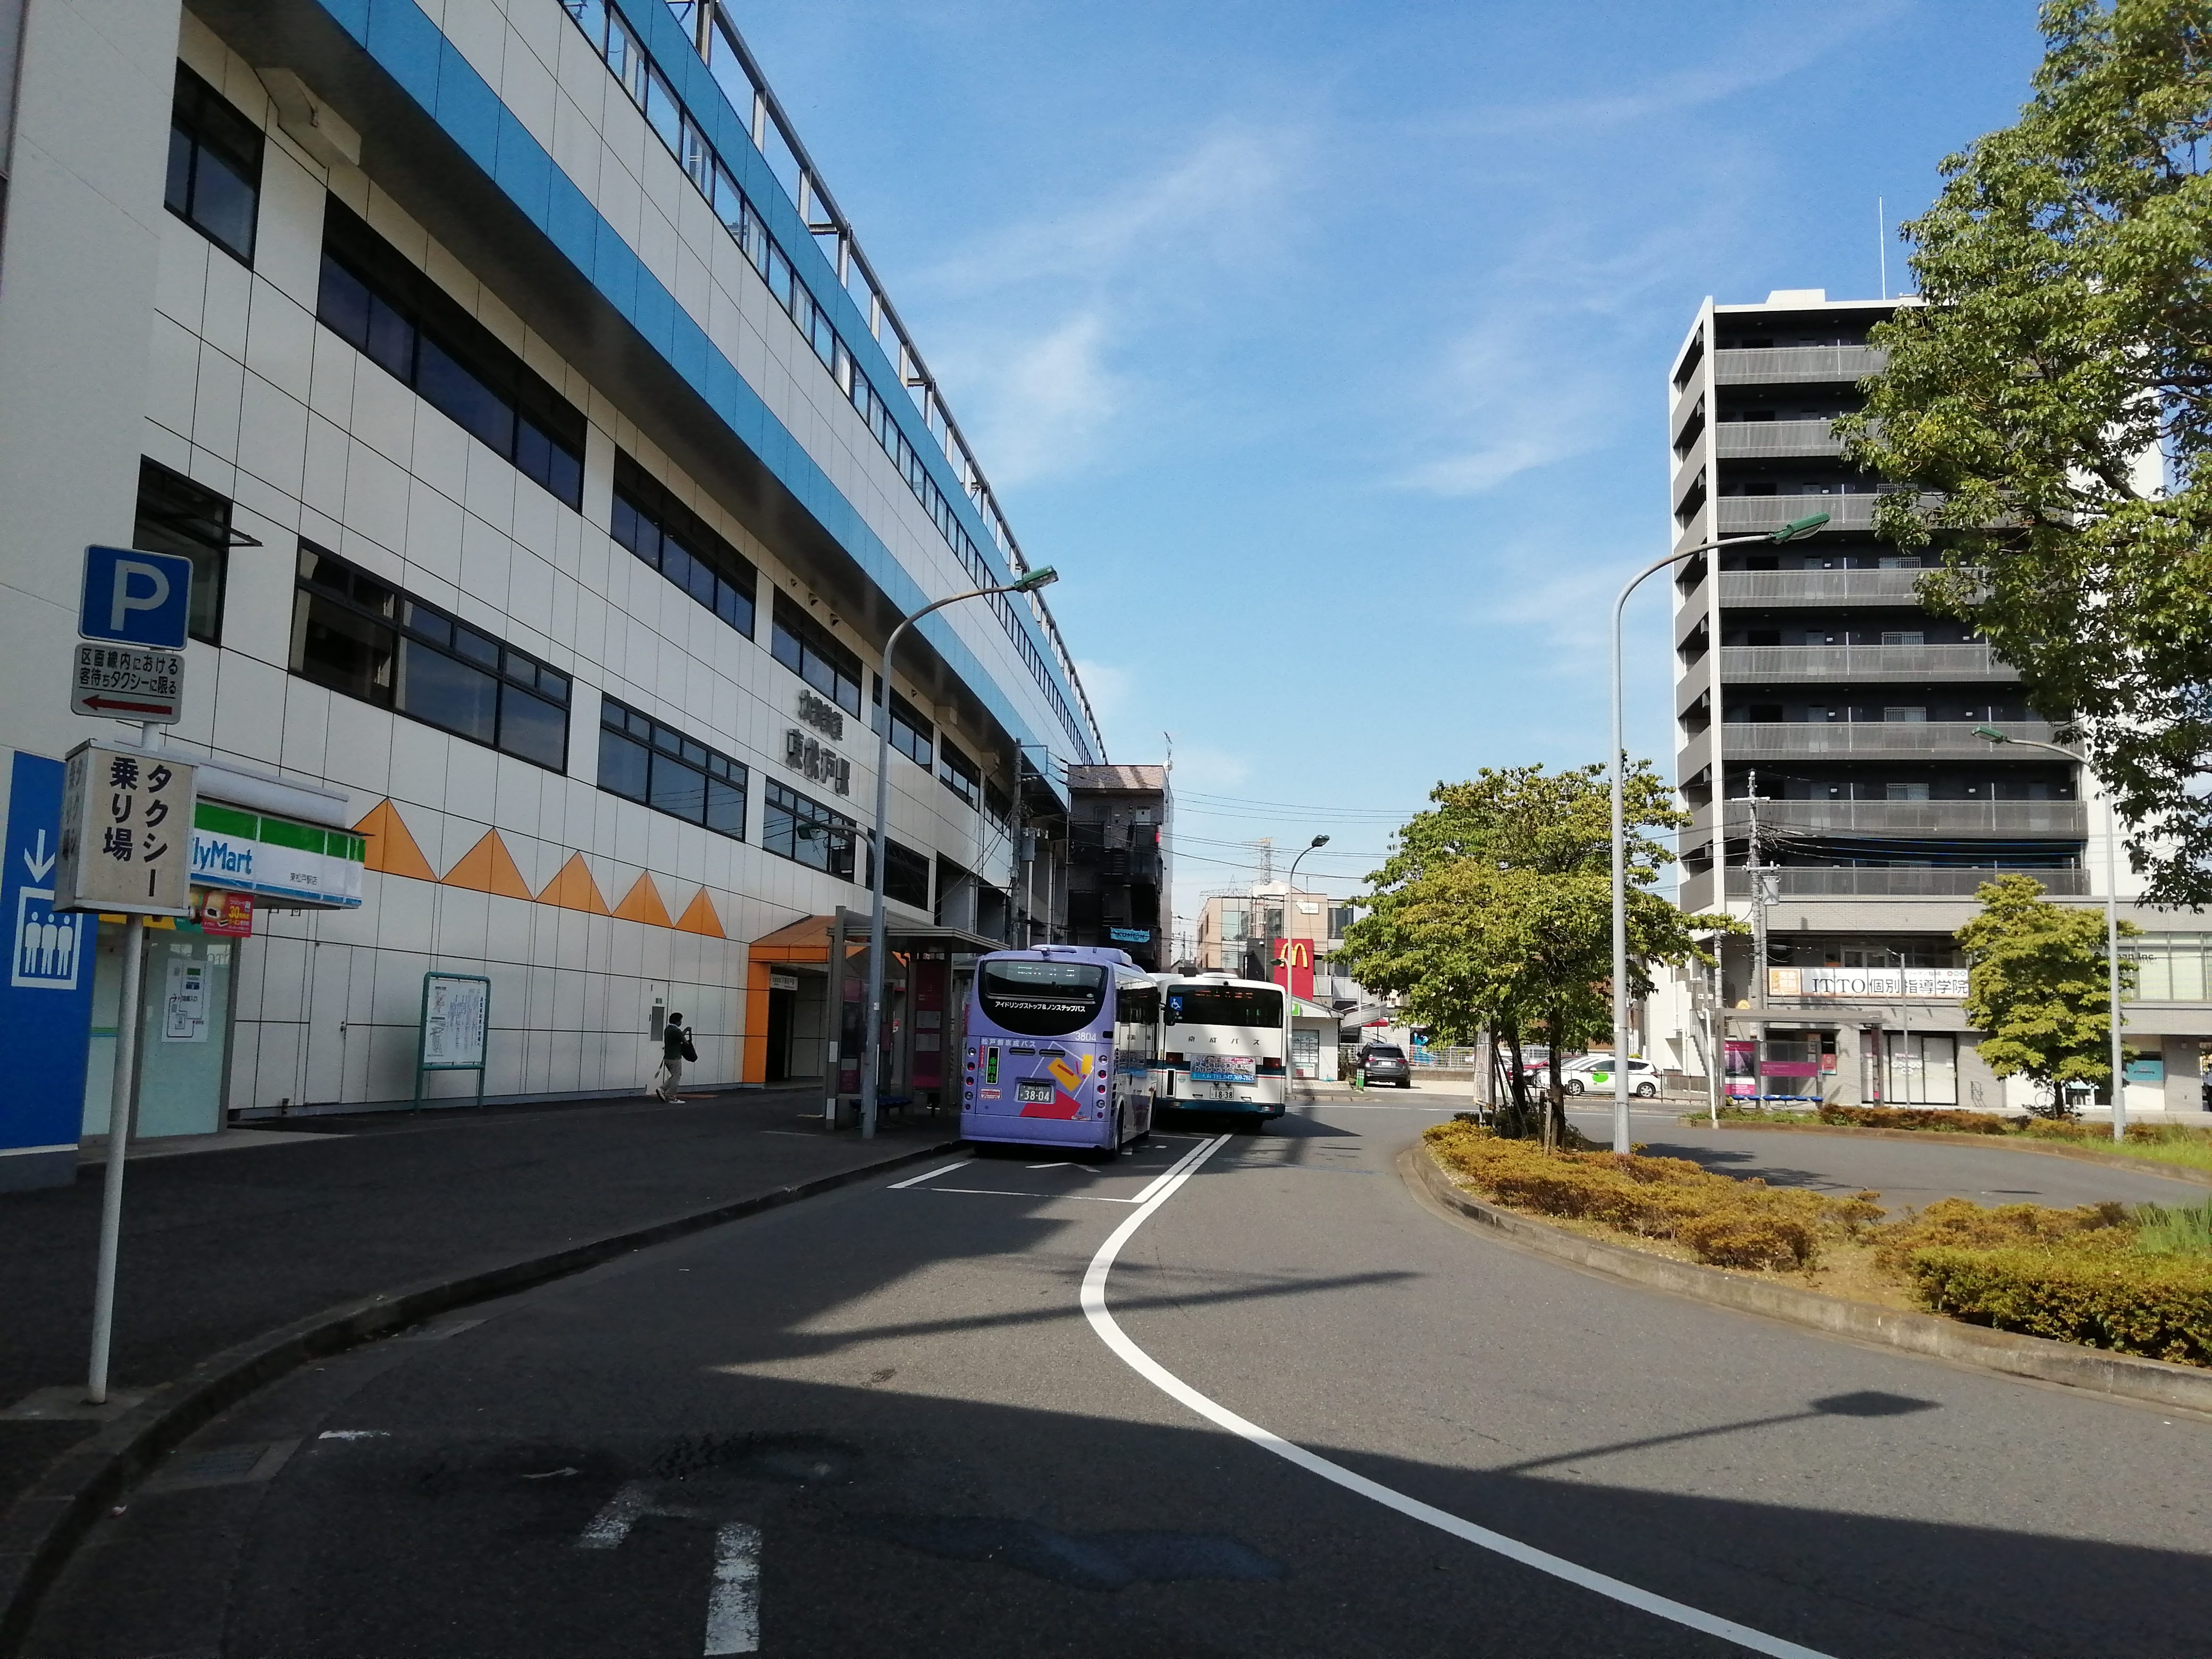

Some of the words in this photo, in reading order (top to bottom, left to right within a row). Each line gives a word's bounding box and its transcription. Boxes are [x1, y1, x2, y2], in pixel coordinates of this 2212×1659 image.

[110, 559, 170, 632] P
[81, 648, 178, 675] 区画線内における
[80, 667, 177, 694] 客待ちタクシーに限る
[102, 756, 139, 862] 乗り場
[143, 764, 172, 897] タクシー
[193, 836, 253, 875] lyMart
[290, 872, 318, 886] 東松戸駅店
[1117, 932, 1145, 940] KUMON
[981, 1038, 1036, 1048] 松戸新京成バス
[1075, 1032, 1097, 1042] 3804
[988, 1057, 996, 1083] 乗降中
[1024, 1090, 1050, 1102] 38-04
